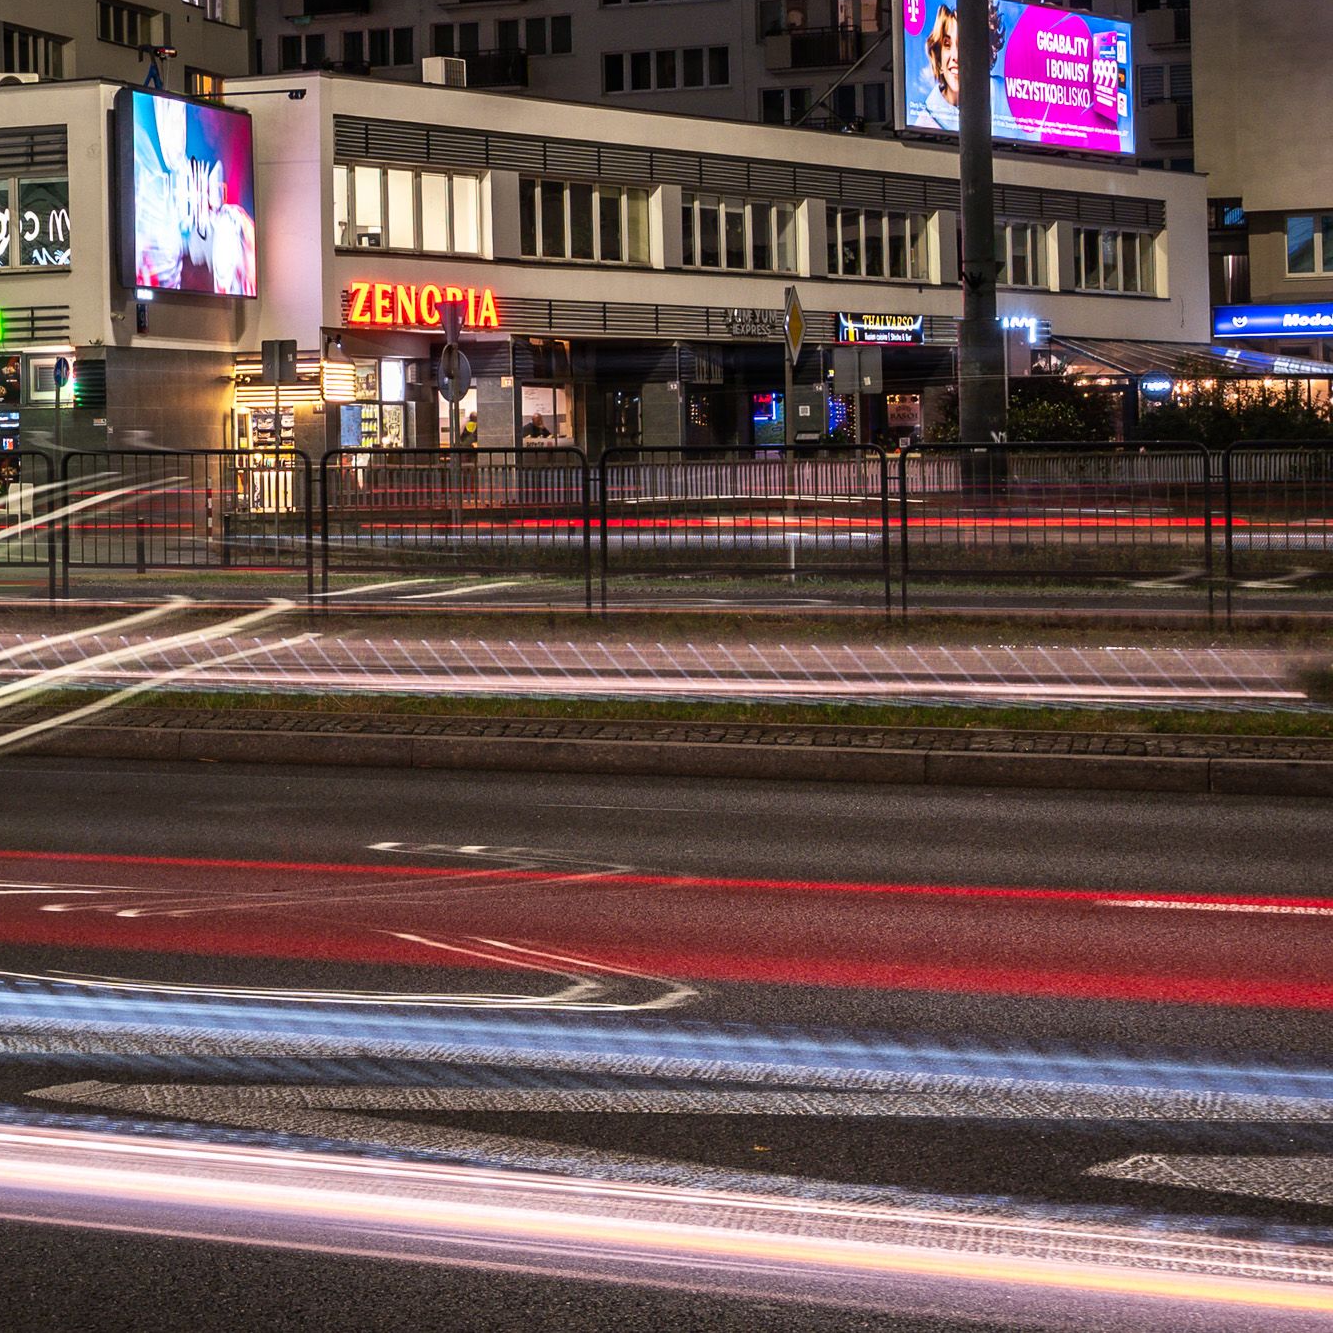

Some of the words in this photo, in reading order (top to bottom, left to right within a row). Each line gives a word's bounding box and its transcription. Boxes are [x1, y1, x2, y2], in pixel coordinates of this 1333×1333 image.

[1036, 30, 1089, 58] GIGABAJTY
[1051, 59, 1090, 83] BONUSY
[1005, 76, 1091, 109] WSZYSTKOBLISKO
[727, 309, 753, 322] YUM
[755, 309, 777, 323] YUM
[735, 324, 772, 335] EXPRESS
